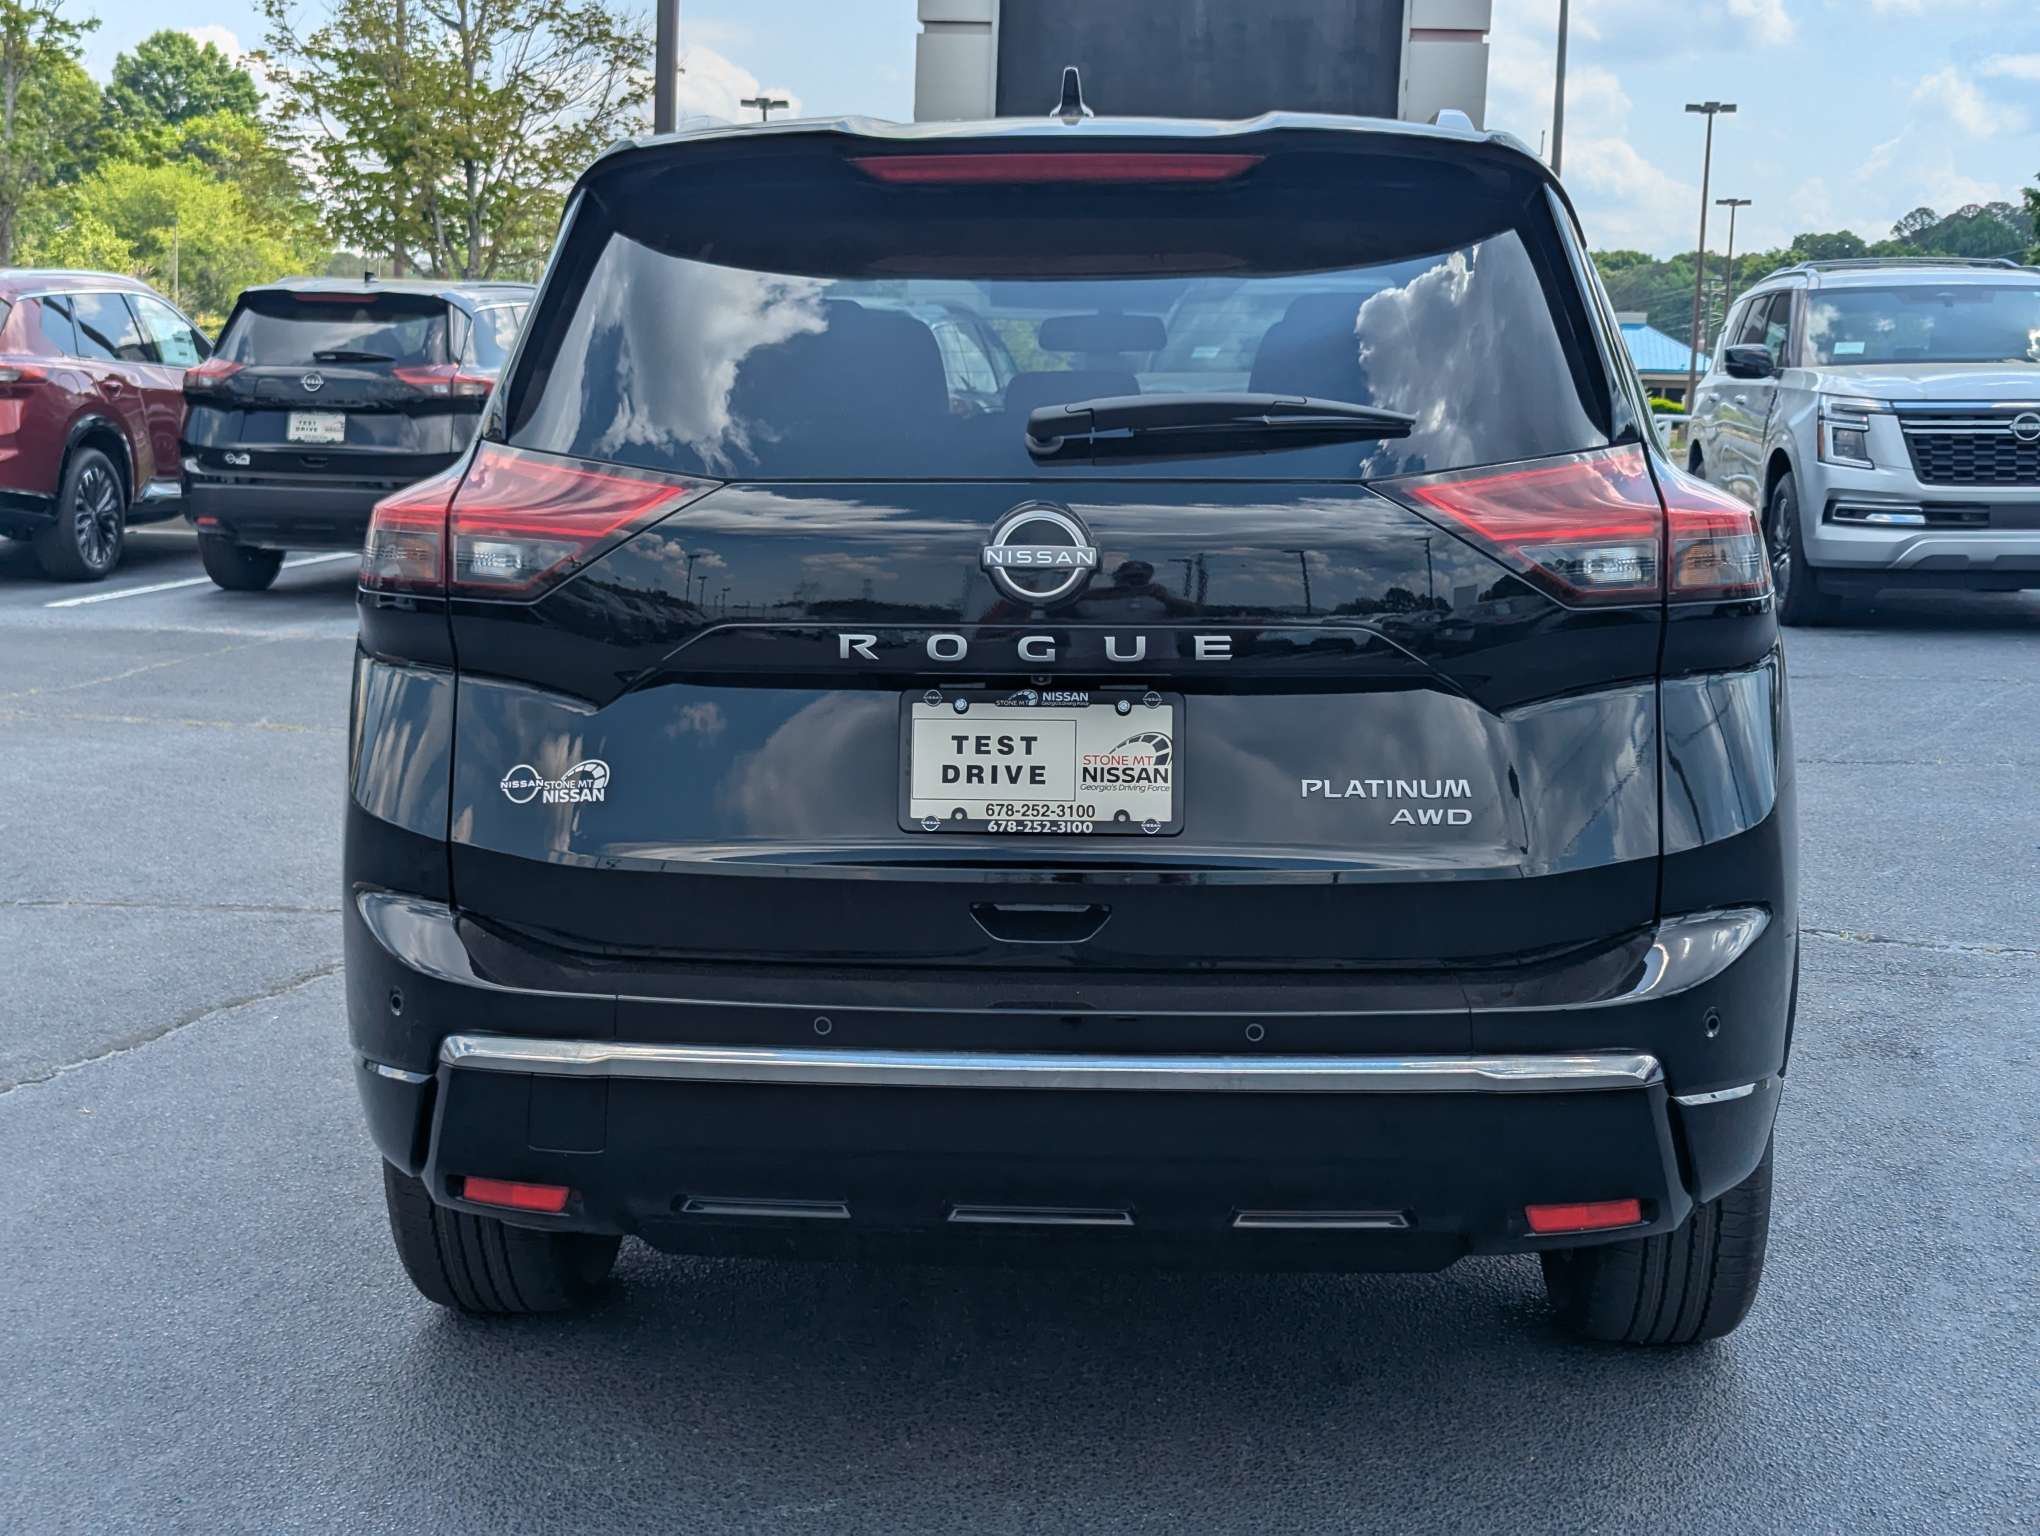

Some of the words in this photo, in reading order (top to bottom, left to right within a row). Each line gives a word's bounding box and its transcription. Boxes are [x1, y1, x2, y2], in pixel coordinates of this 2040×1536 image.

[986, 549, 1093, 565] NISSAN
[838, 633, 1233, 662] ROGUE
[1042, 692, 1089, 701] NISSAN
[951, 735, 1038, 755] TEST
[1083, 755, 1129, 766] STONE
[1133, 755, 1153, 766] MT
[942, 764, 1046, 784] DRIVE
[1082, 767, 1169, 783] NISSAN
[500, 779, 544, 789] NISSAN
[544, 780, 576, 790] STONE
[578, 779, 593, 788] MT
[1080, 784, 1118, 793] Georgia's
[1119, 784, 1146, 794] Driving
[1301, 779, 1473, 798] PLATINUM
[542, 788, 605, 804] NISSAN
[985, 803, 1096, 818] 678-252-3100
[1389, 808, 1473, 825] AWD
[987, 820, 1094, 834] 678-252-3100
